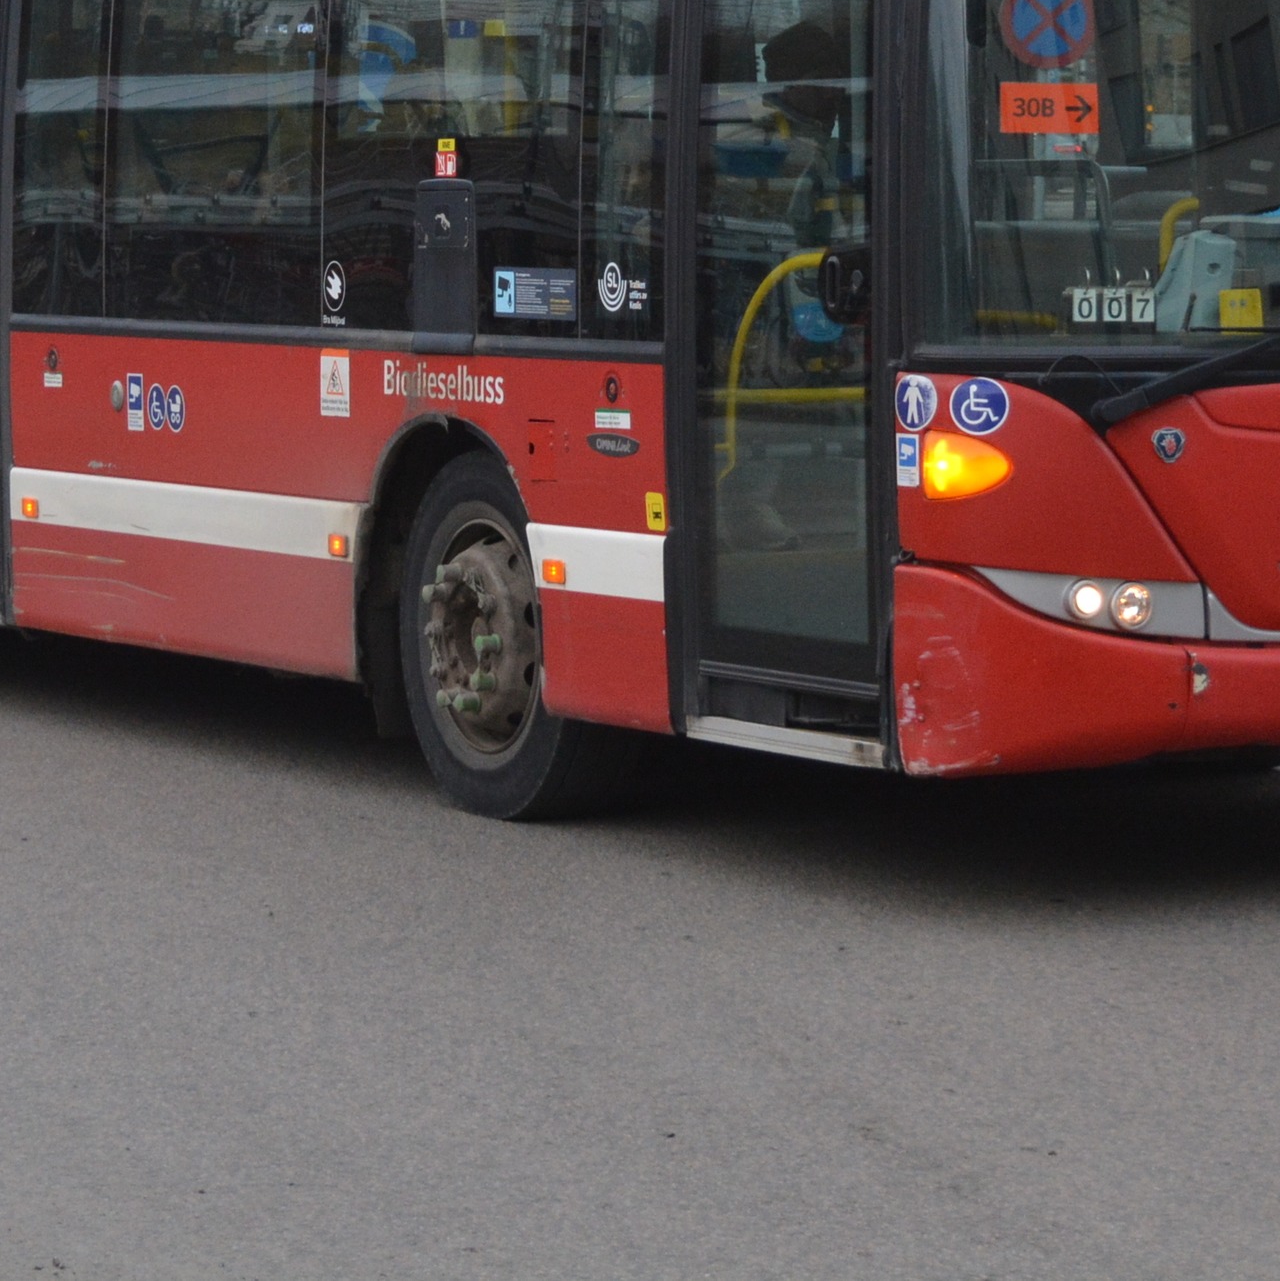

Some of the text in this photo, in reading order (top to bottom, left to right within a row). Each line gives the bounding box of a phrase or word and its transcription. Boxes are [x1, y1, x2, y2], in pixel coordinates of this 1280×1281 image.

[1012, 97, 1056, 118] 30B
[606, 271, 619, 289] SL
[383, 358, 506, 406] Biodieselbuss
